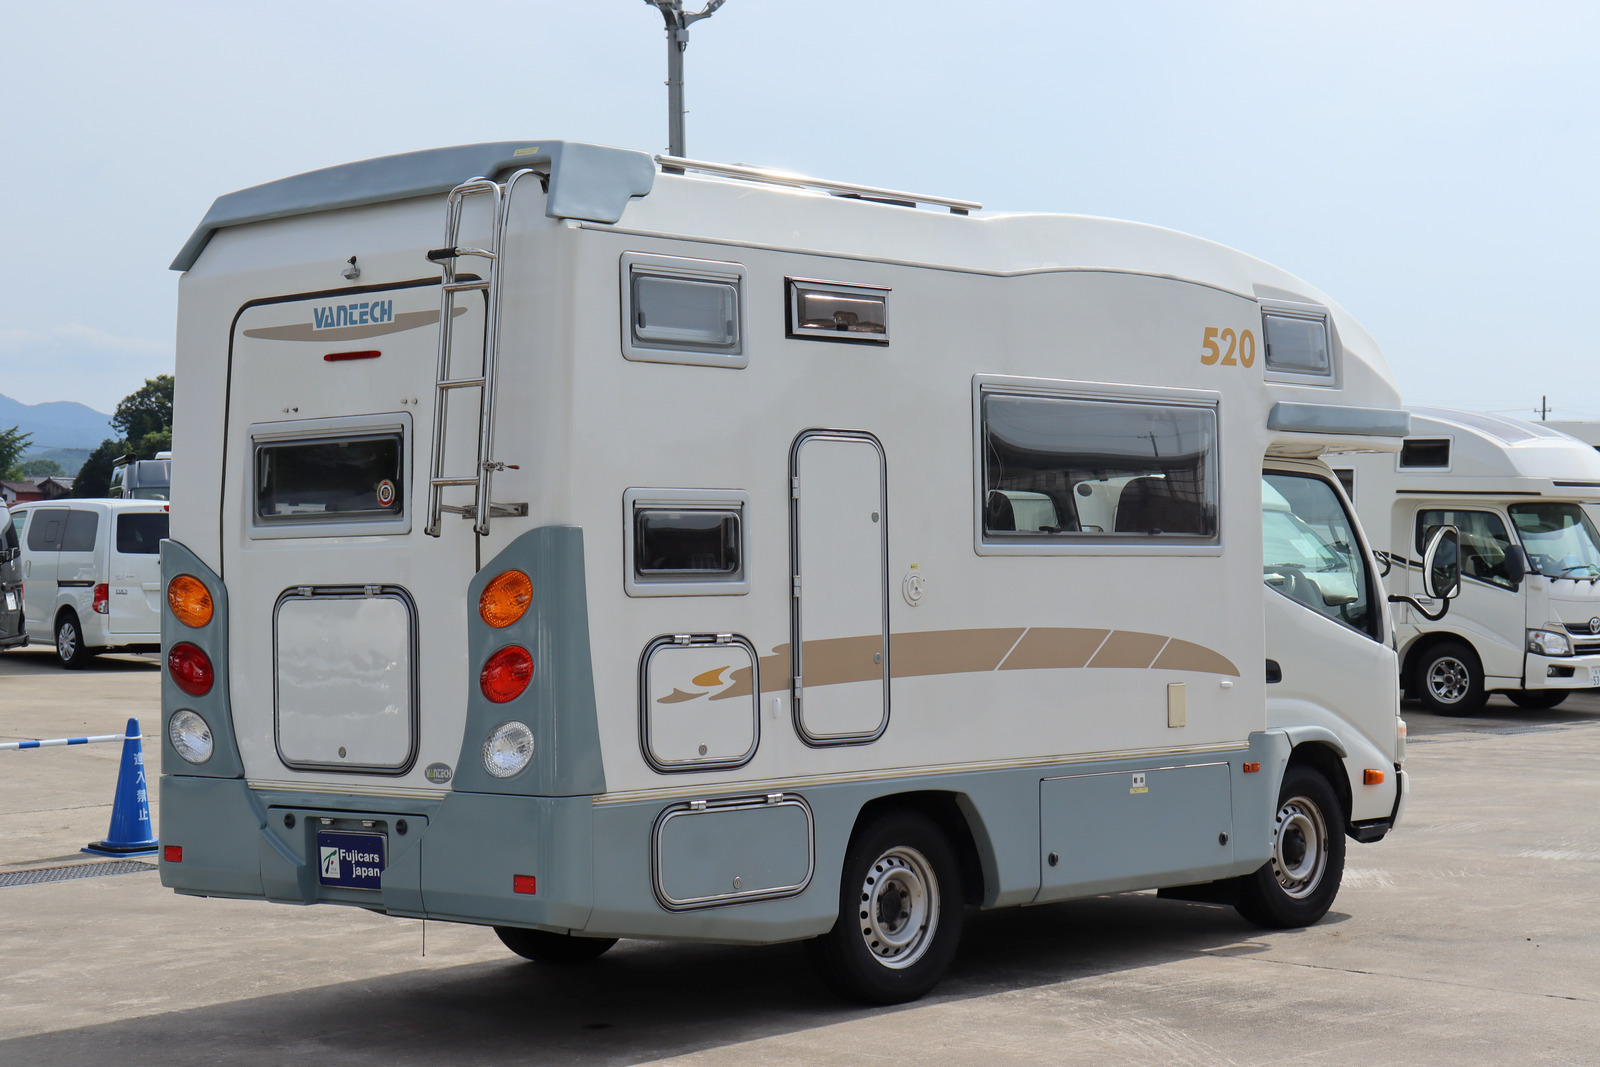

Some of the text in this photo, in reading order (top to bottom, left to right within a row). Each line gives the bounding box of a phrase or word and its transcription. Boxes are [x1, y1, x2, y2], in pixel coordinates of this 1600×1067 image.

[313, 300, 393, 329] VANTECH
[1200, 326, 1256, 369] 520
[133, 751, 149, 821] 進入禁止
[340, 848, 380, 864] Fujicars
[352, 863, 380, 879] japan
